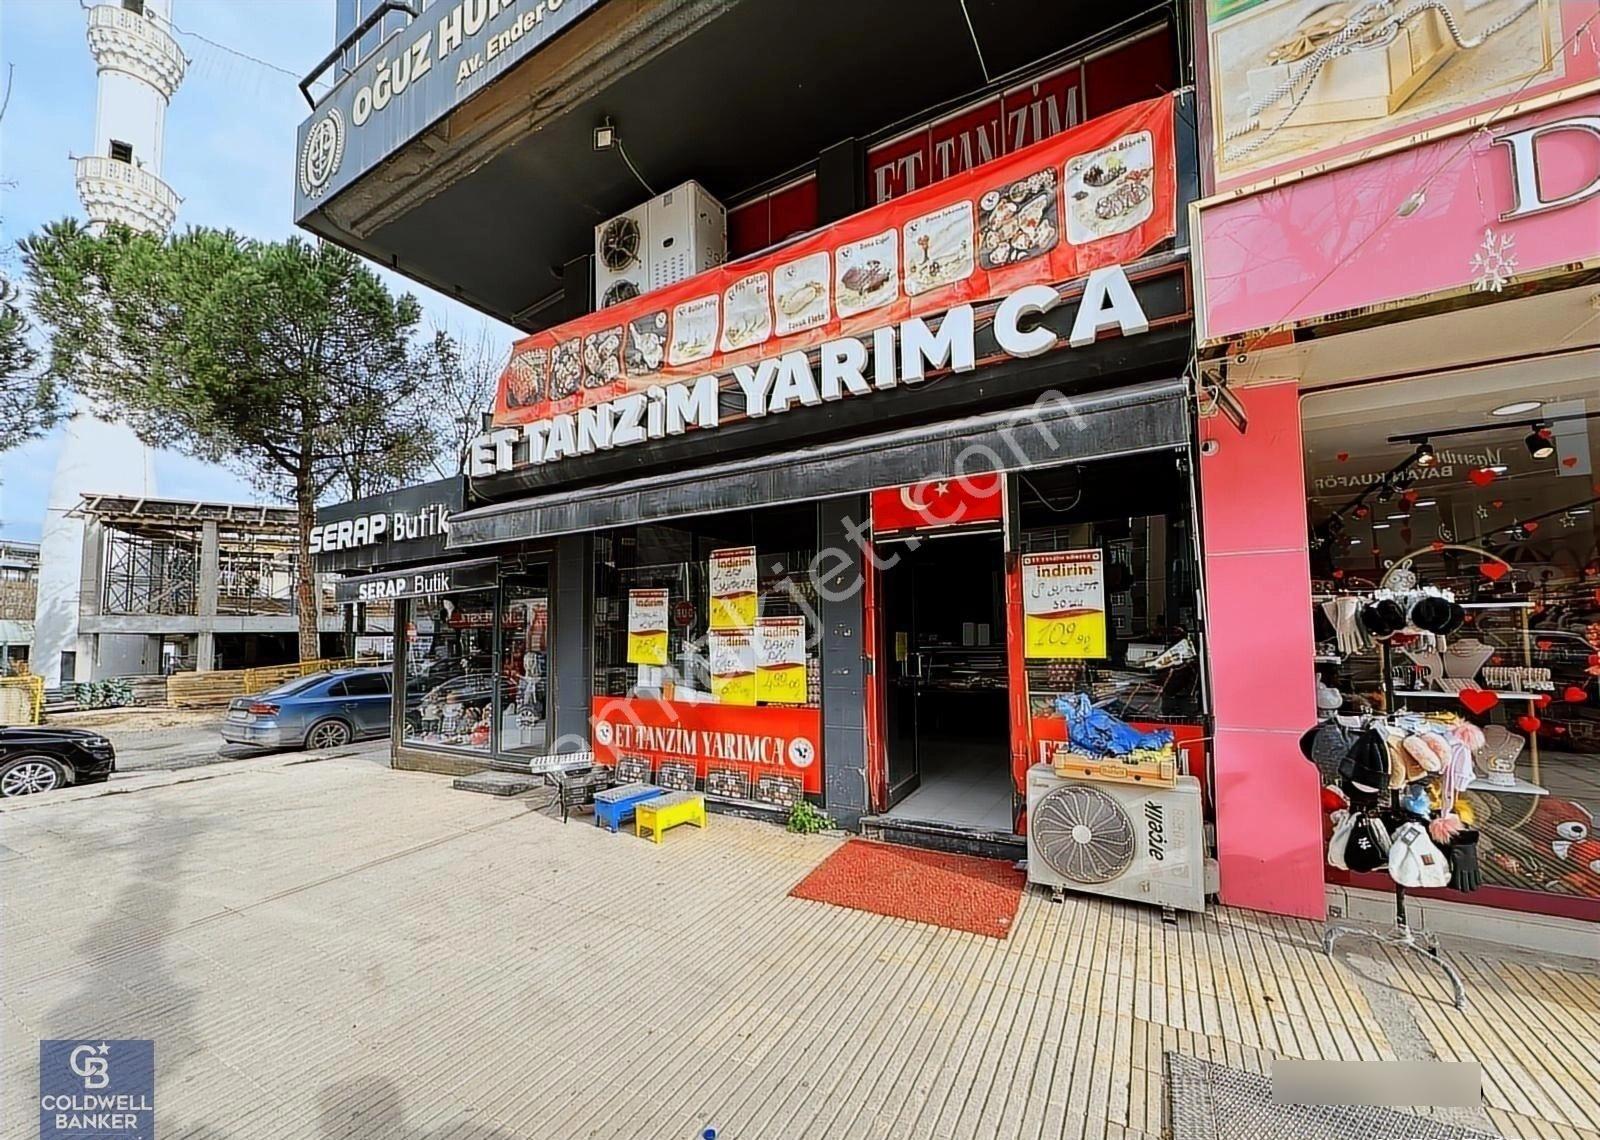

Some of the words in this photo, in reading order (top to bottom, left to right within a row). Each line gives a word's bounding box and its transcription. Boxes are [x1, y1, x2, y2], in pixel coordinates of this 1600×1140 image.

[456, 53, 485, 85] Av.
[487, 2, 547, 61] Ender
[352, 30, 433, 127] OĞUZ
[874, 152, 924, 205] ET
[470, 428, 519, 478] ET
[308, 513, 388, 555] SERAP
[393, 503, 451, 542] Butik
[358, 577, 407, 600] SERAP
[414, 572, 450, 594] Butik
[1036, 564, 1093, 578] indirim
[615, 723, 634, 749] ET
[635, 722, 697, 756] TANZİM
[702, 731, 785, 766] YARIMCA
[1145, 800, 1167, 861] arçelik
